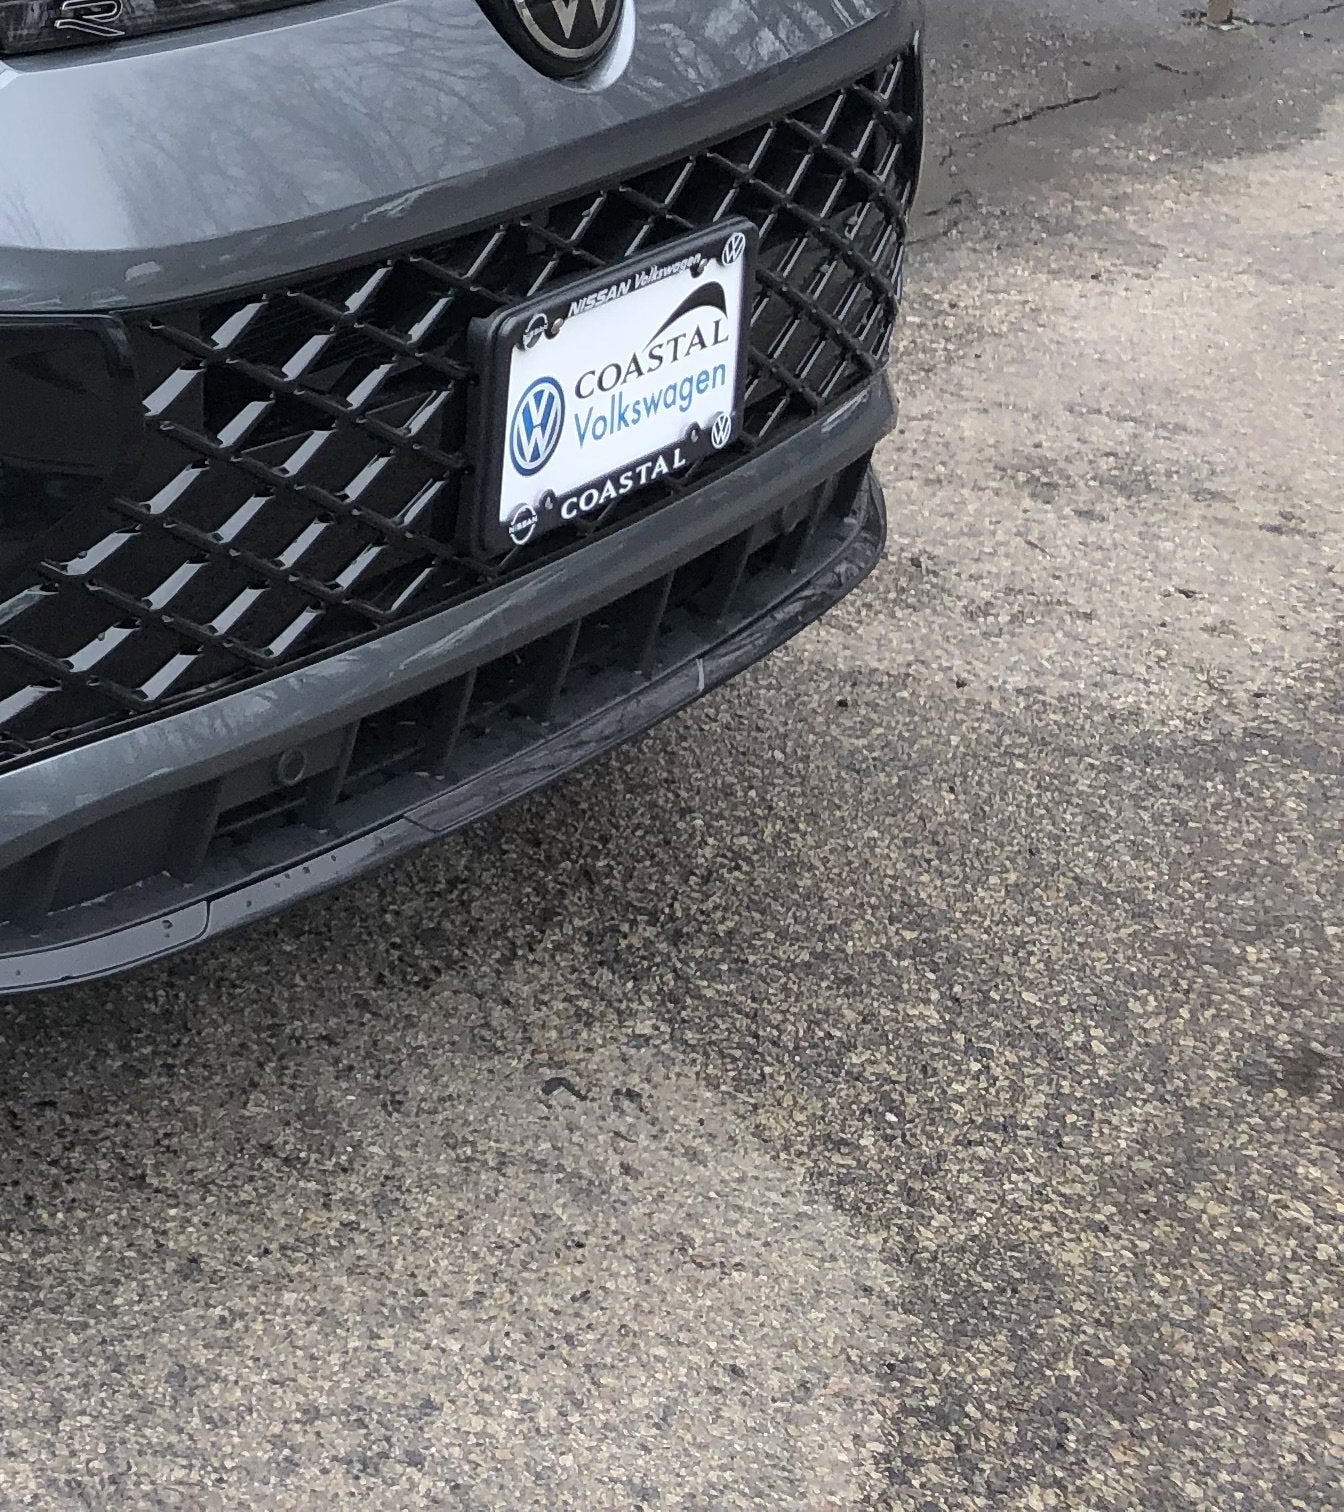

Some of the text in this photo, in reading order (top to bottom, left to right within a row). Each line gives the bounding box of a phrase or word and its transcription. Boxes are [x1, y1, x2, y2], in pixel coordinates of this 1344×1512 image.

[568, 253, 702, 317] NISSAN Volkswagen
[574, 318, 730, 400] COASTAL
[573, 363, 727, 448] Volkswagen
[560, 448, 687, 520] COASTAL
